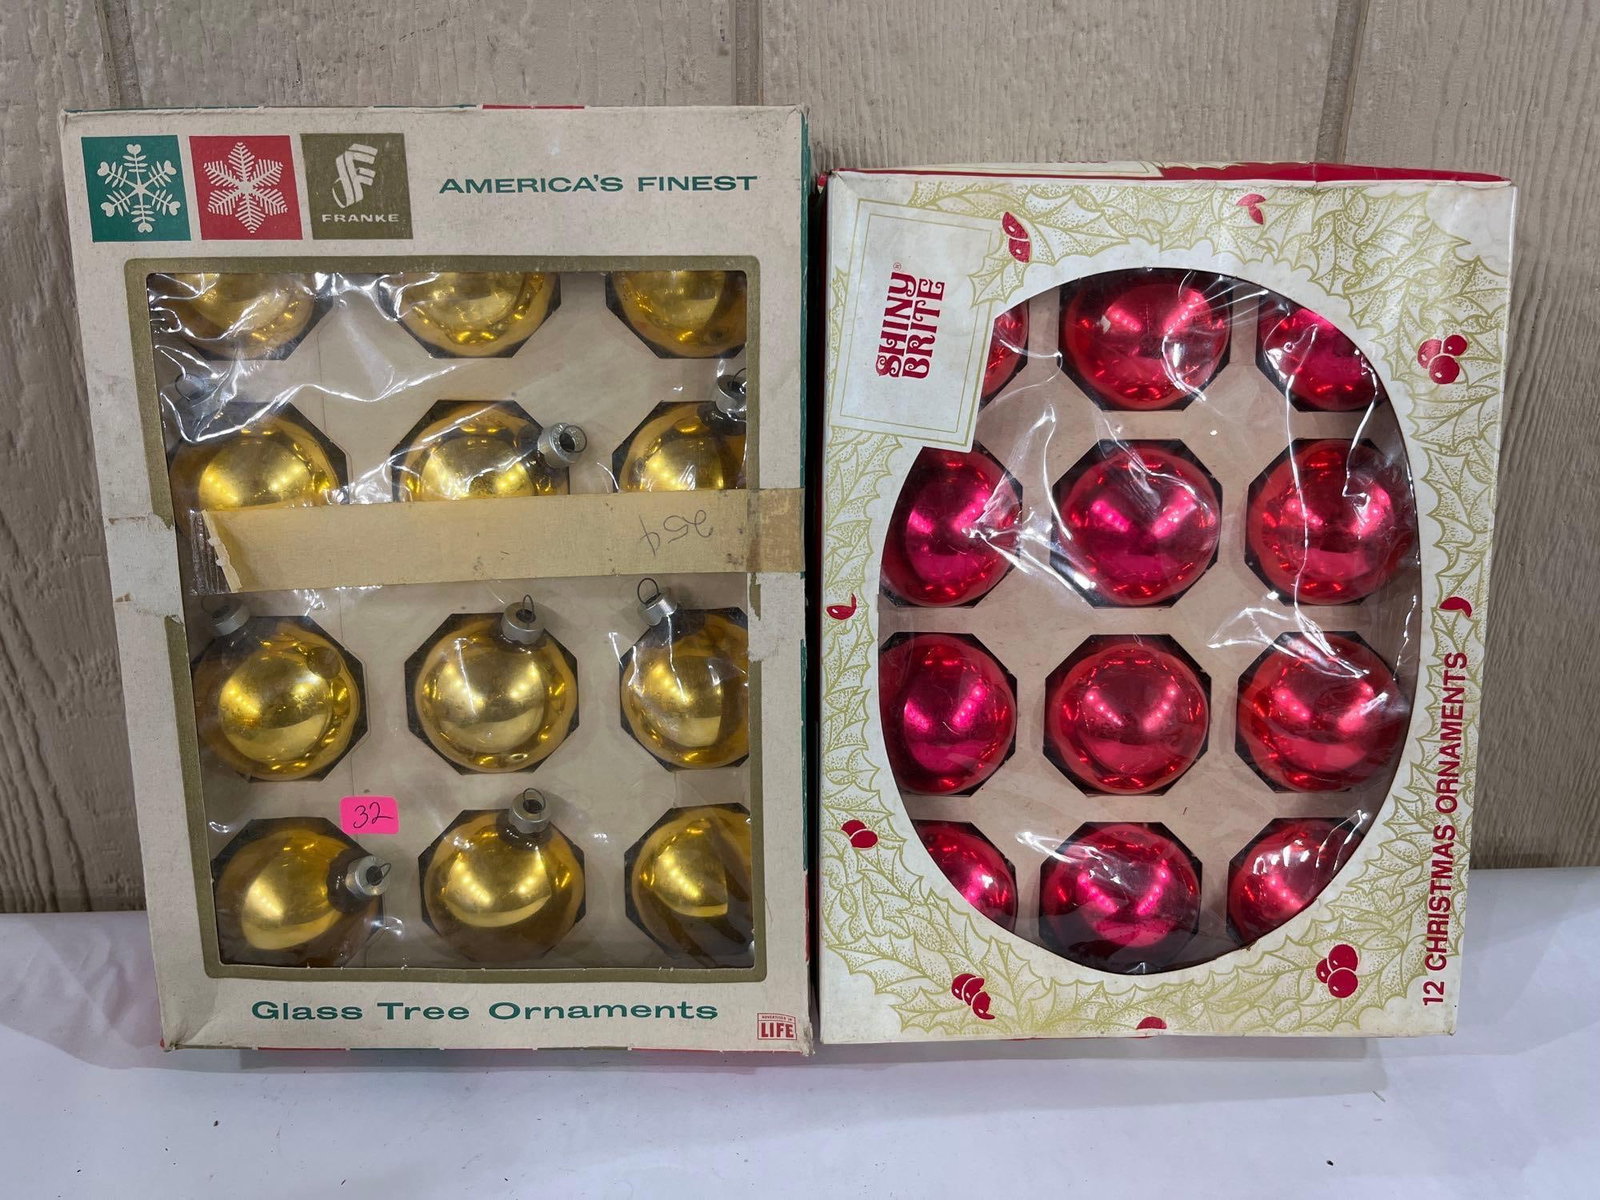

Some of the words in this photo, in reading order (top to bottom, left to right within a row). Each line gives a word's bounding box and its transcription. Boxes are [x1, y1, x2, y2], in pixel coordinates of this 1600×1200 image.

[439, 174, 623, 194] AMERICA'S
[638, 175, 757, 192] FINEST
[321, 213, 400, 223] FRANKE
[901, 278, 945, 379] BRITE
[1435, 651, 1468, 814] ORNAMENTS
[352, 801, 394, 829] 32
[1423, 824, 1456, 972] CHRISTMAS
[1422, 980, 1444, 1006] 12
[251, 1000, 363, 1020] Glass
[376, 1002, 470, 1021] Tree
[488, 1001, 718, 1020] Ornaments
[760, 1022, 794, 1038] LIFE
